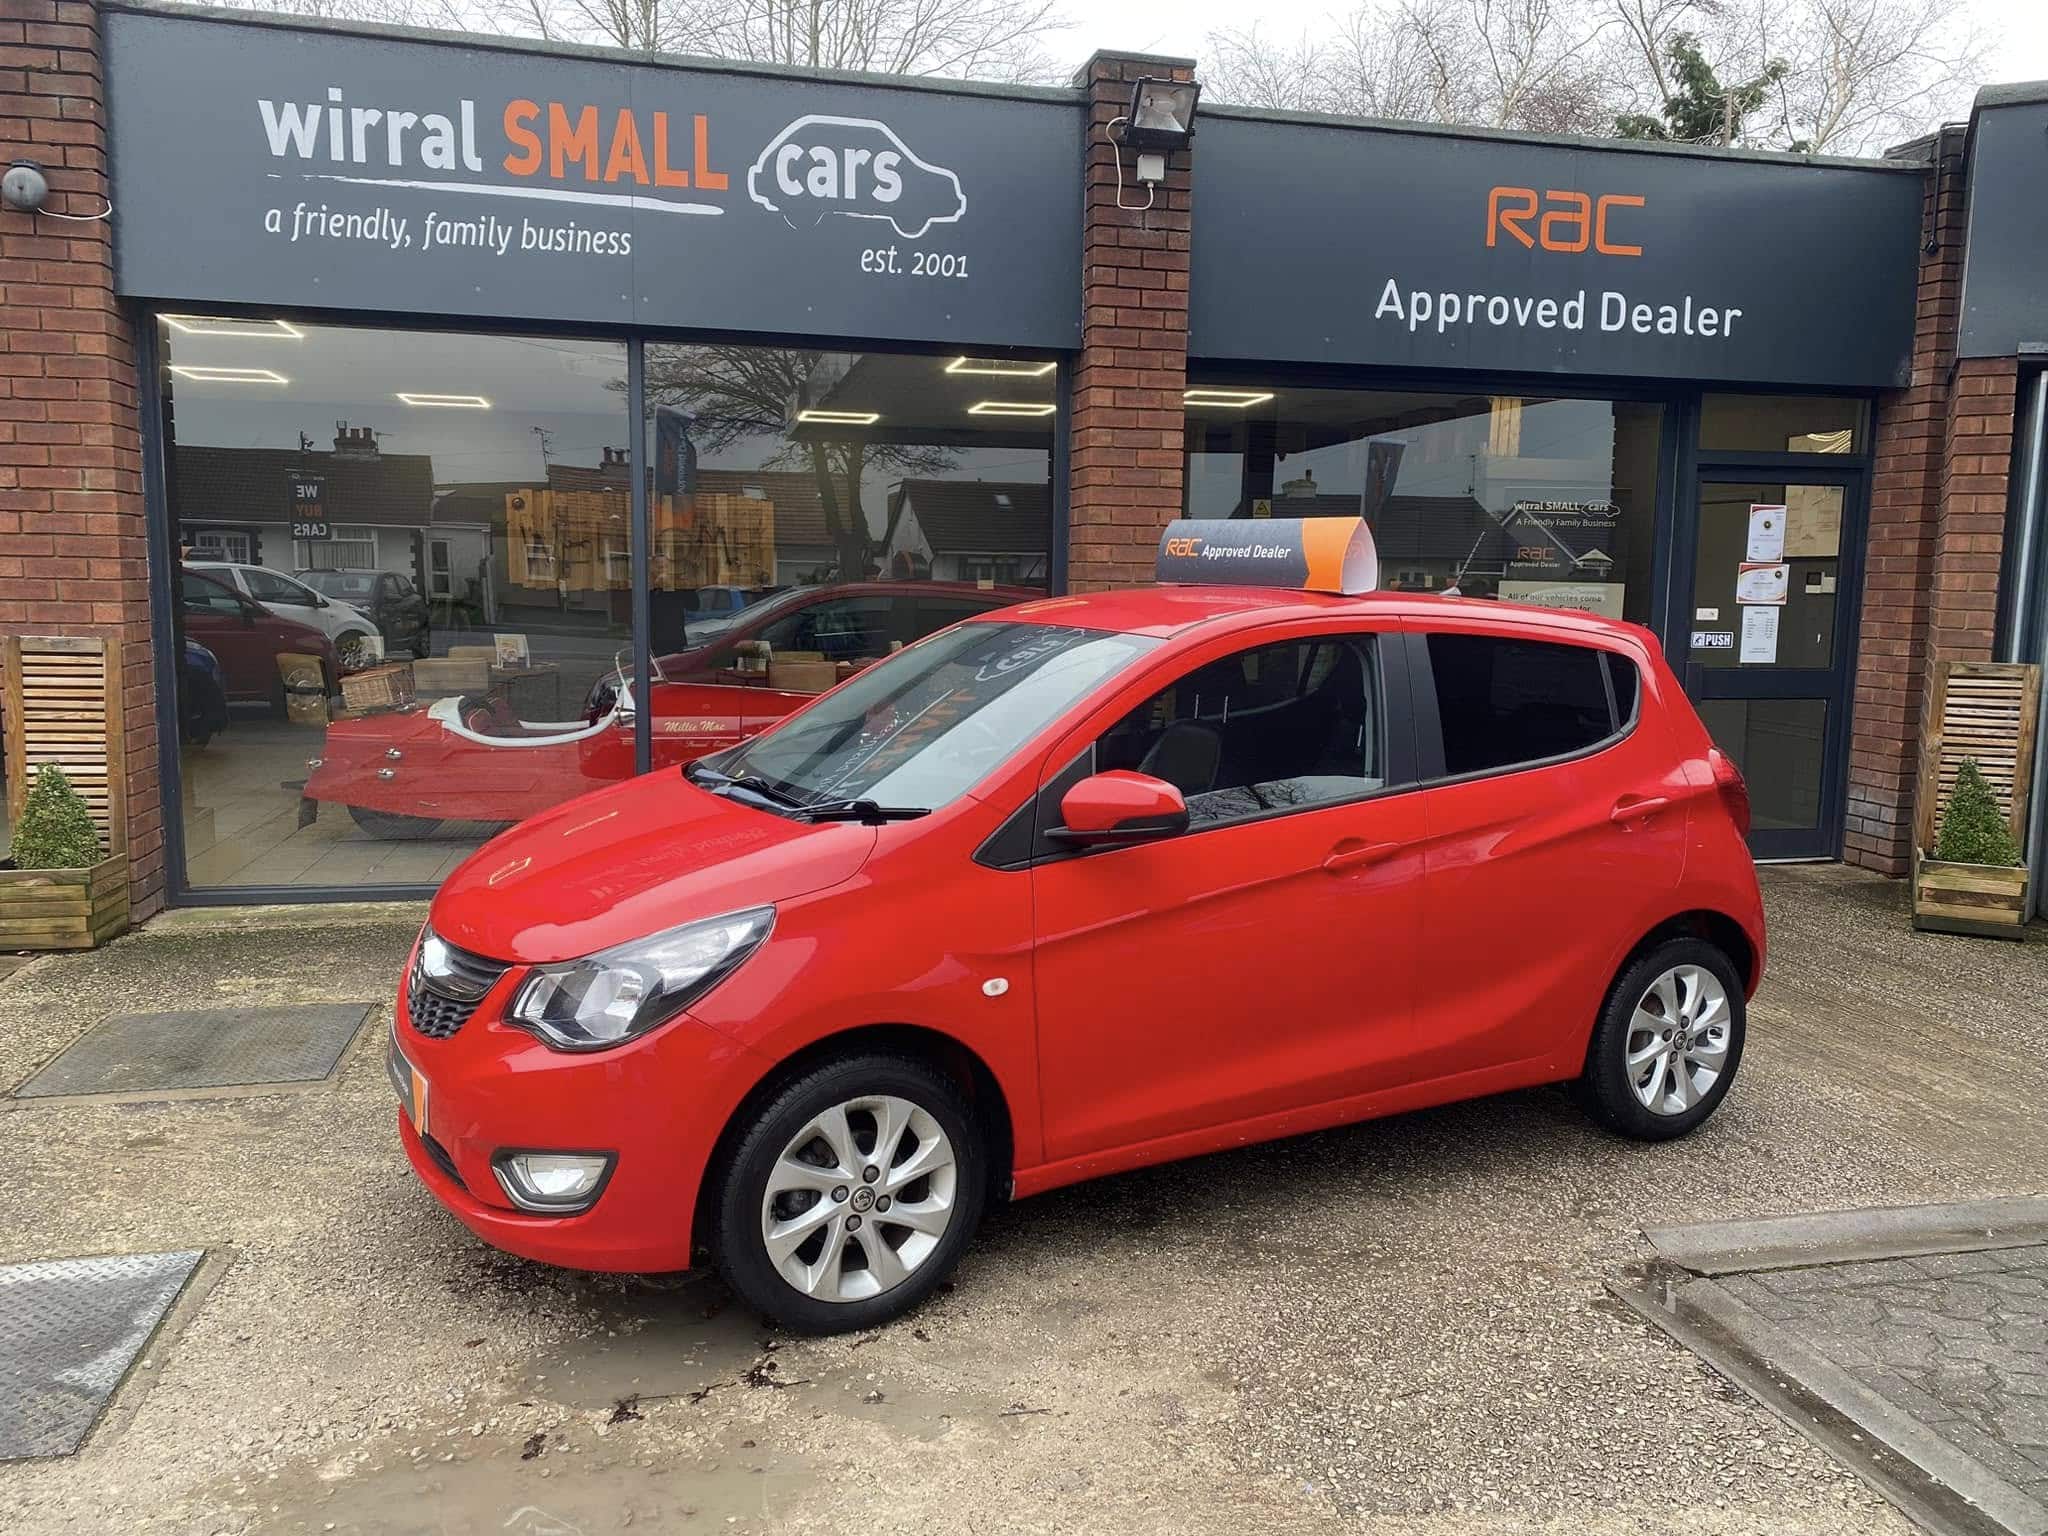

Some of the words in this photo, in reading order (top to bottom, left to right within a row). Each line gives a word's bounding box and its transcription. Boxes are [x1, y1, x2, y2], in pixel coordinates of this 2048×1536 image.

[257, 87, 484, 173] wirral
[502, 98, 729, 191] SMALL
[775, 143, 903, 203] cars
[264, 206, 282, 234] a
[287, 203, 412, 250] friendly,
[422, 212, 512, 255] family
[521, 217, 632, 255] business
[860, 247, 903, 275] est.
[911, 251, 970, 279] 2001
[1374, 278, 1586, 334] Approved
[1601, 291, 1743, 337] Dealer
[1545, 501, 1581, 511] SMALL
[1588, 503, 1609, 511] cars
[1556, 519, 1581, 528] Family
[1582, 520, 1616, 528] Business
[1201, 544, 1251, 561] Approved
[1252, 544, 1291, 560] Dealer
[1705, 633, 1731, 647] PUSH
